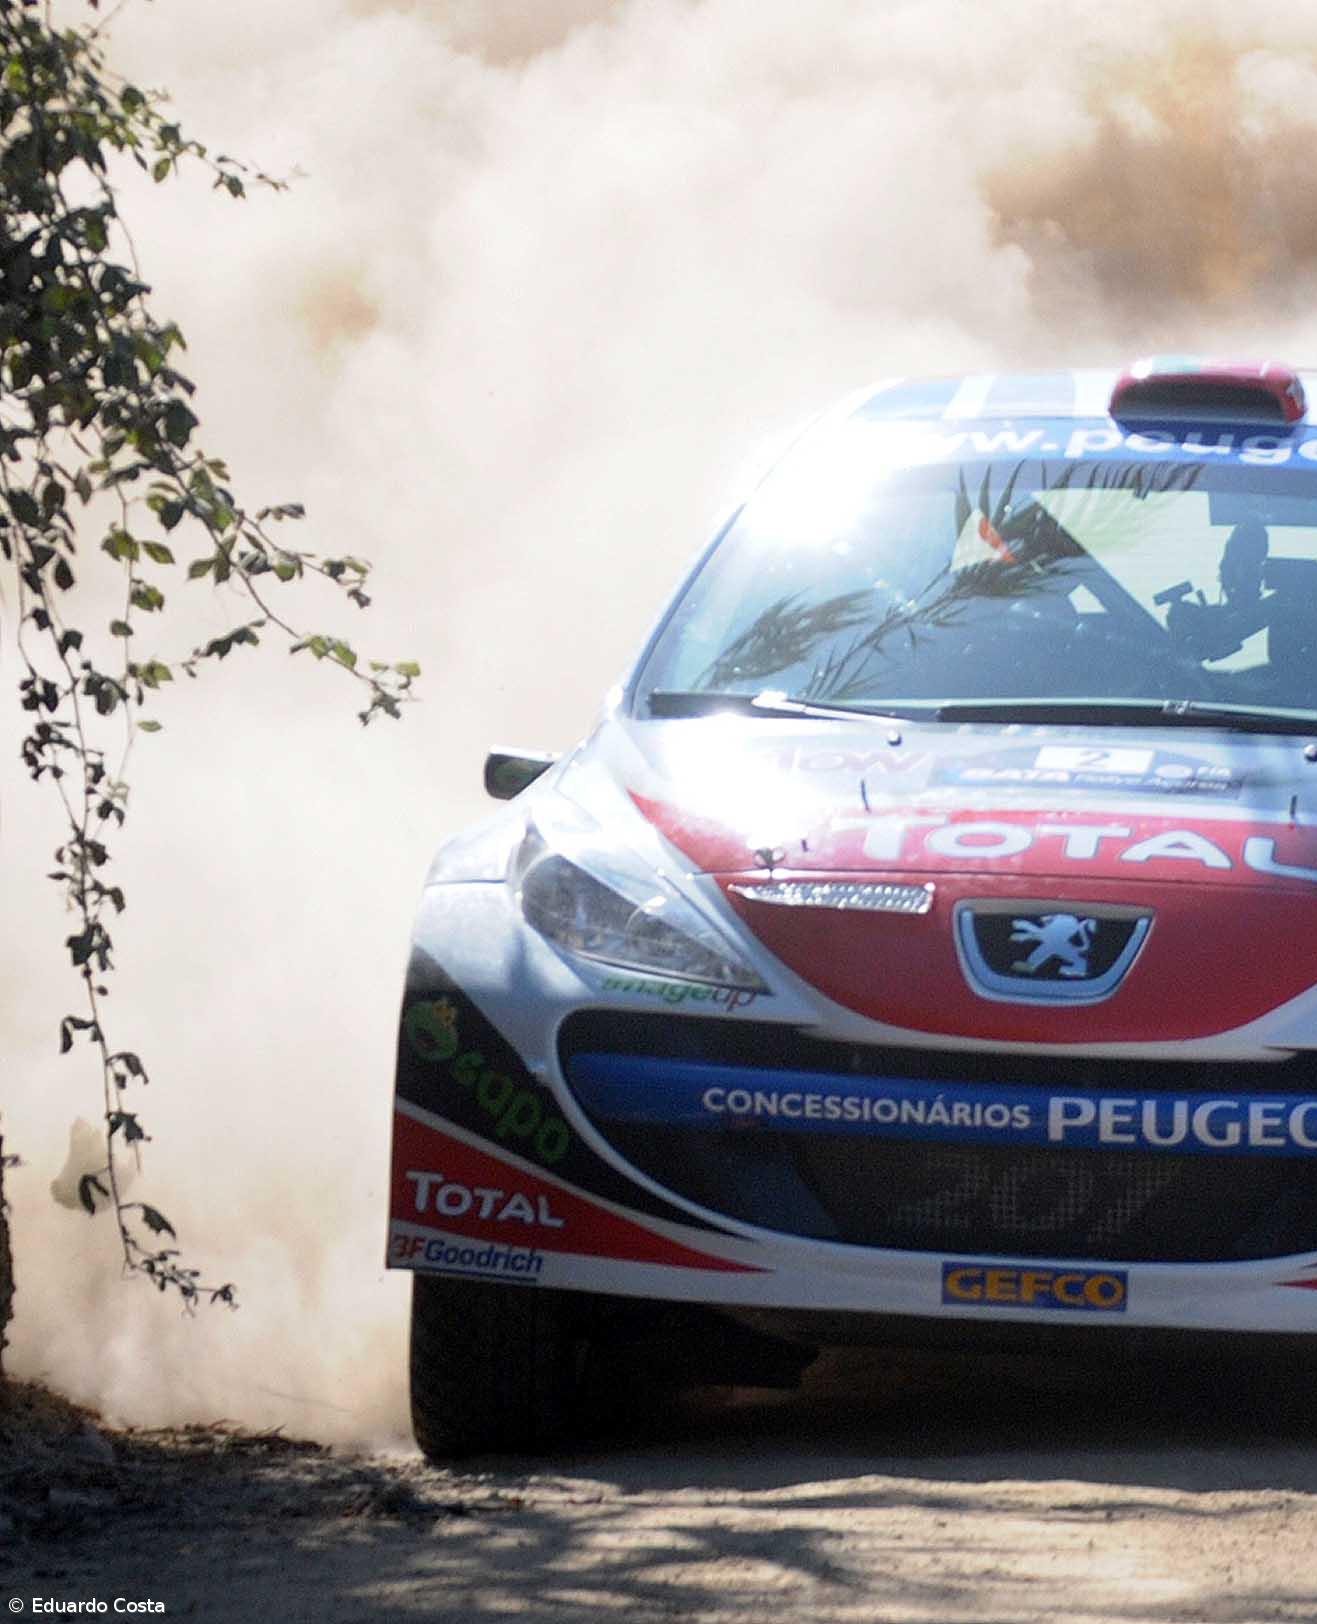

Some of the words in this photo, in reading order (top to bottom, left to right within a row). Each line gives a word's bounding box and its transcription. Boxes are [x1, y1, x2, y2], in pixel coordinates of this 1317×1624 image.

[1077, 750, 1112, 768] 2
[702, 1085, 1031, 1131] CONCESSIONÁRIOS
[405, 1169, 568, 1229] TOTAL
[945, 1266, 1125, 1307] GEFCO
